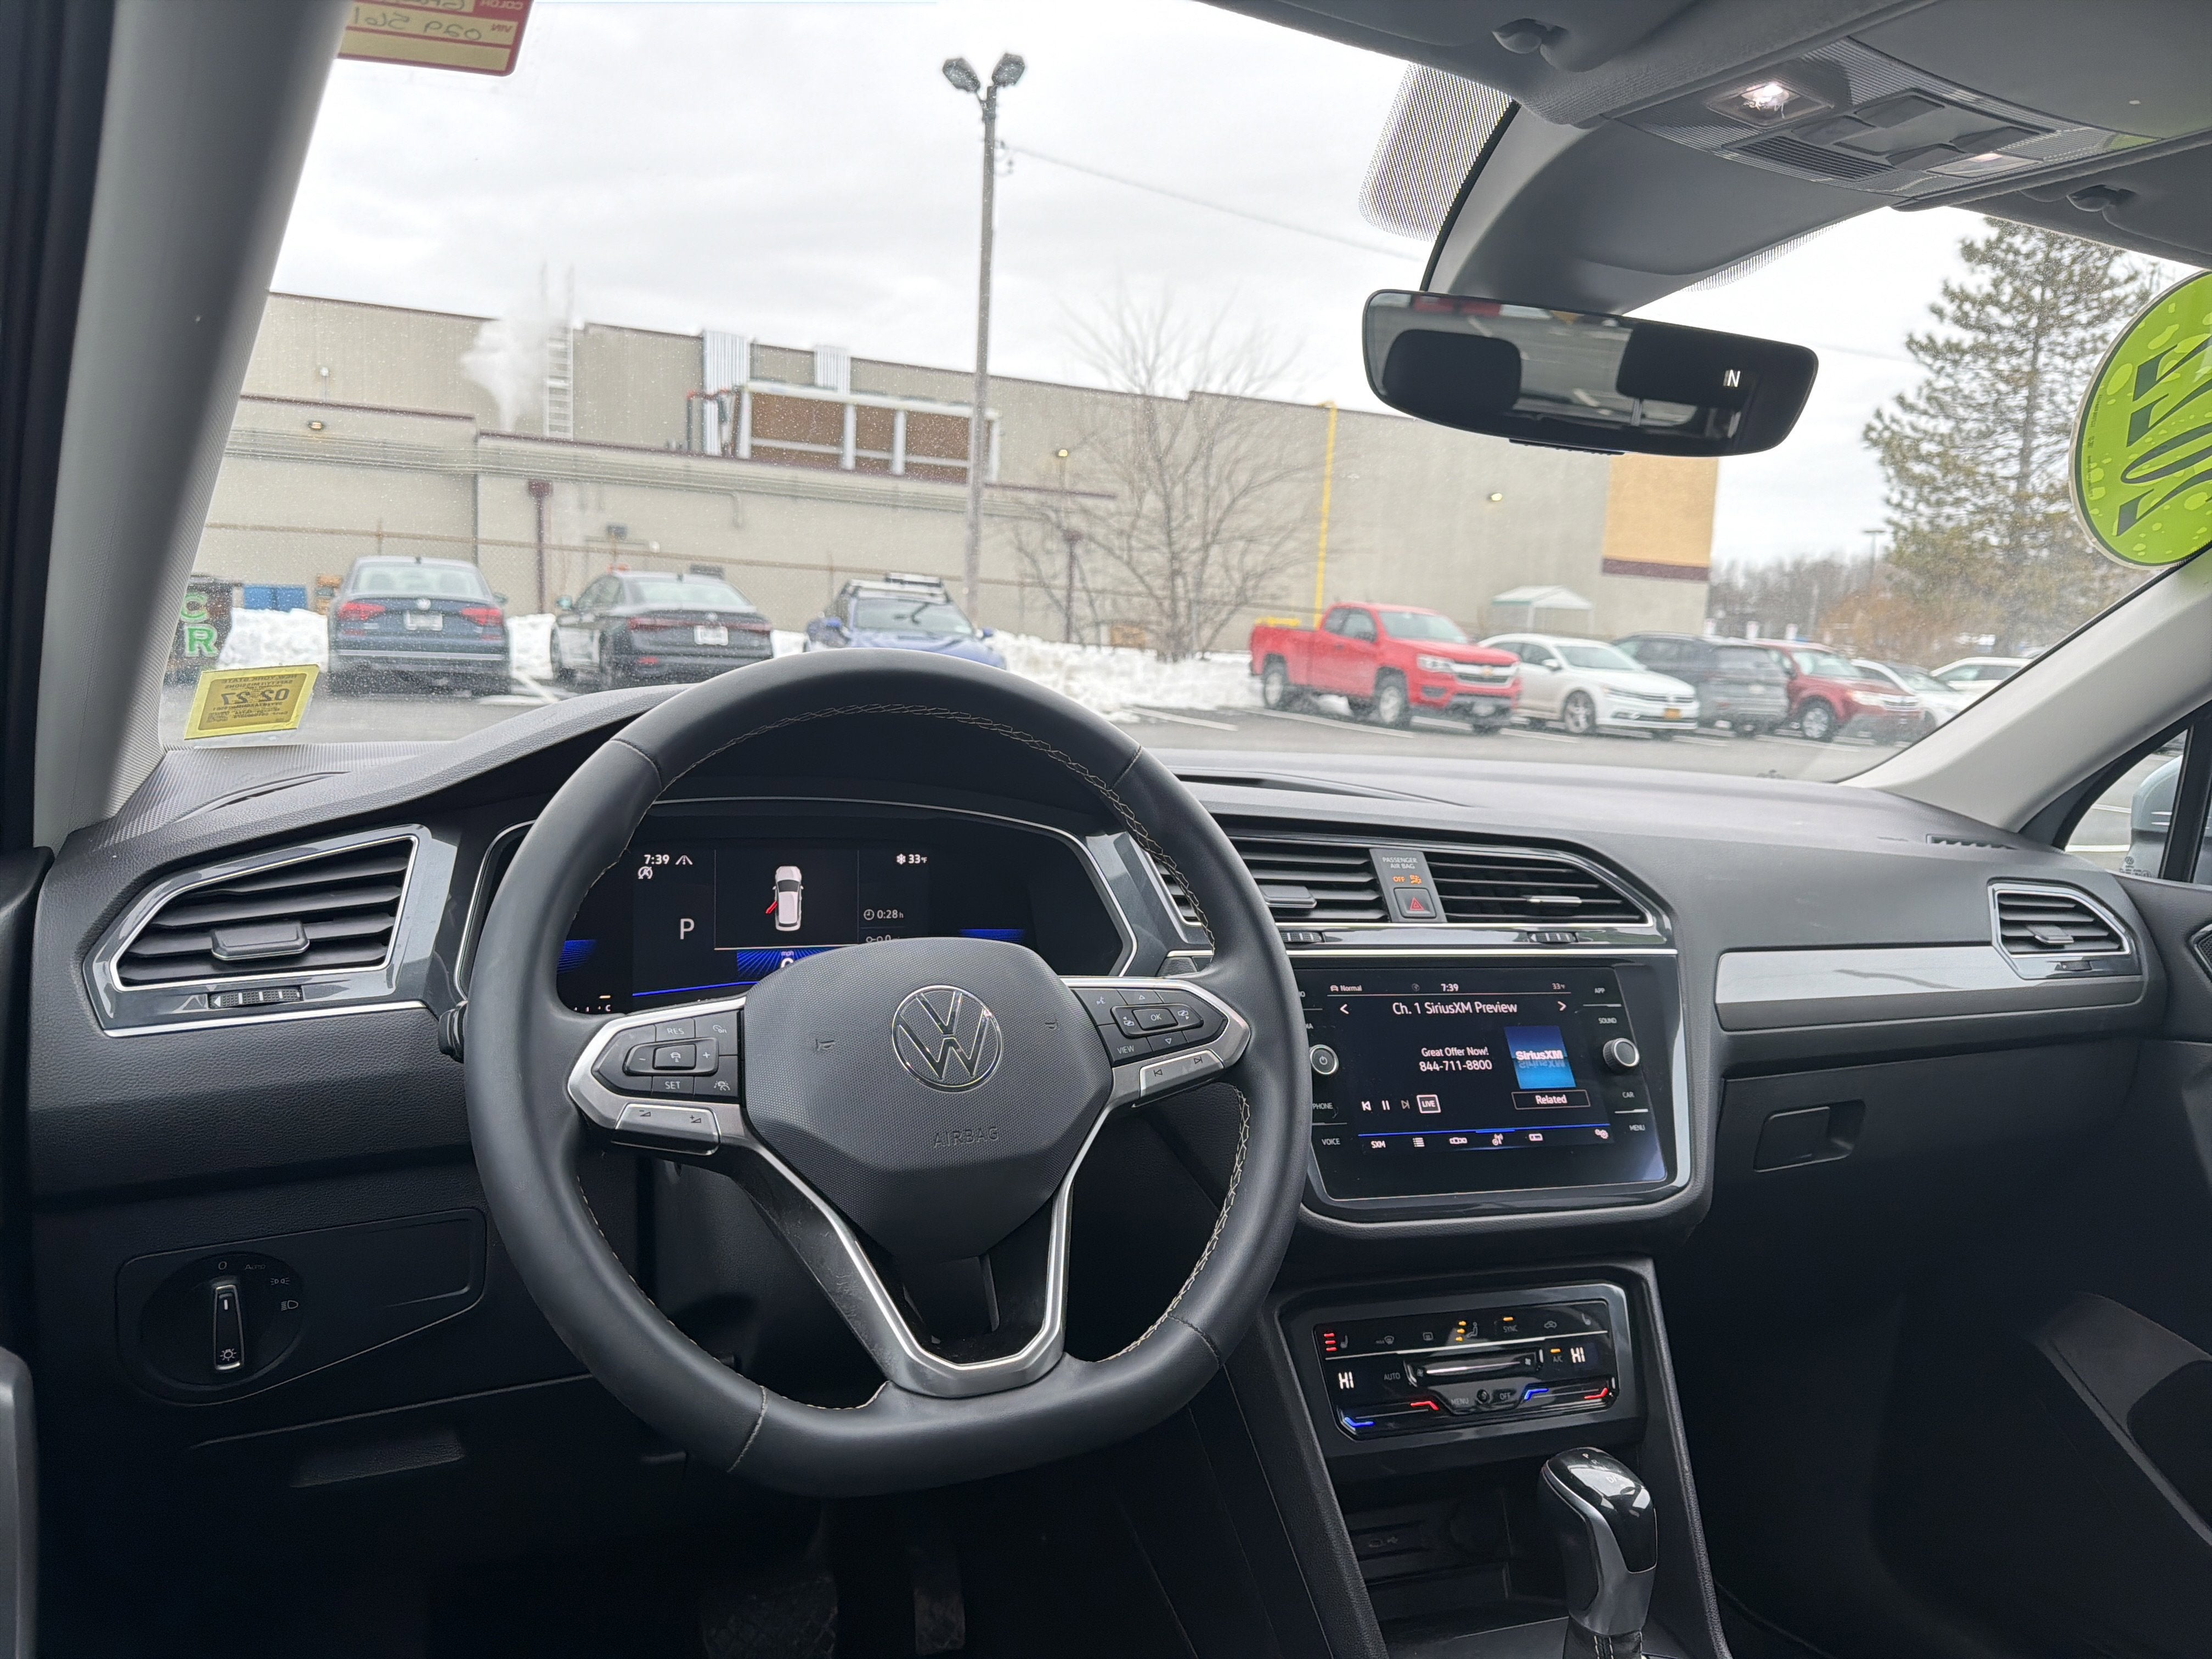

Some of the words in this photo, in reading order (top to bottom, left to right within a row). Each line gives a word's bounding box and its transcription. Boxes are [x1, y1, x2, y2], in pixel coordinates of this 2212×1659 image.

[1727, 369, 1741, 387] N
[644, 854, 670, 865] 7:39
[877, 910, 898, 919] 0:28
[680, 918, 695, 939] P
[1441, 983, 1459, 992] 7:39
[1392, 1002, 1412, 1014] Ch.
[1414, 1002, 1421, 1014] 1
[1424, 1002, 1472, 1014] SiriusXM
[1475, 1001, 1517, 1013] Preview
[1150, 1013, 1163, 1022] OK
[1117, 1045, 1135, 1054] VIEW
[1421, 1047, 1443, 1057] Great
[1444, 1047, 1465, 1056] Offer
[1467, 1046, 1489, 1056] Now!
[1516, 1050, 1564, 1060] SiriusXM
[1419, 1060, 1492, 1071] 844-711-8800
[664, 1081, 681, 1090] SET
[1536, 1094, 1567, 1104] Related
[933, 1127, 999, 1148] AIRBAG
[1570, 1347, 1585, 1363] HI
[1339, 1371, 1354, 1389] HI
